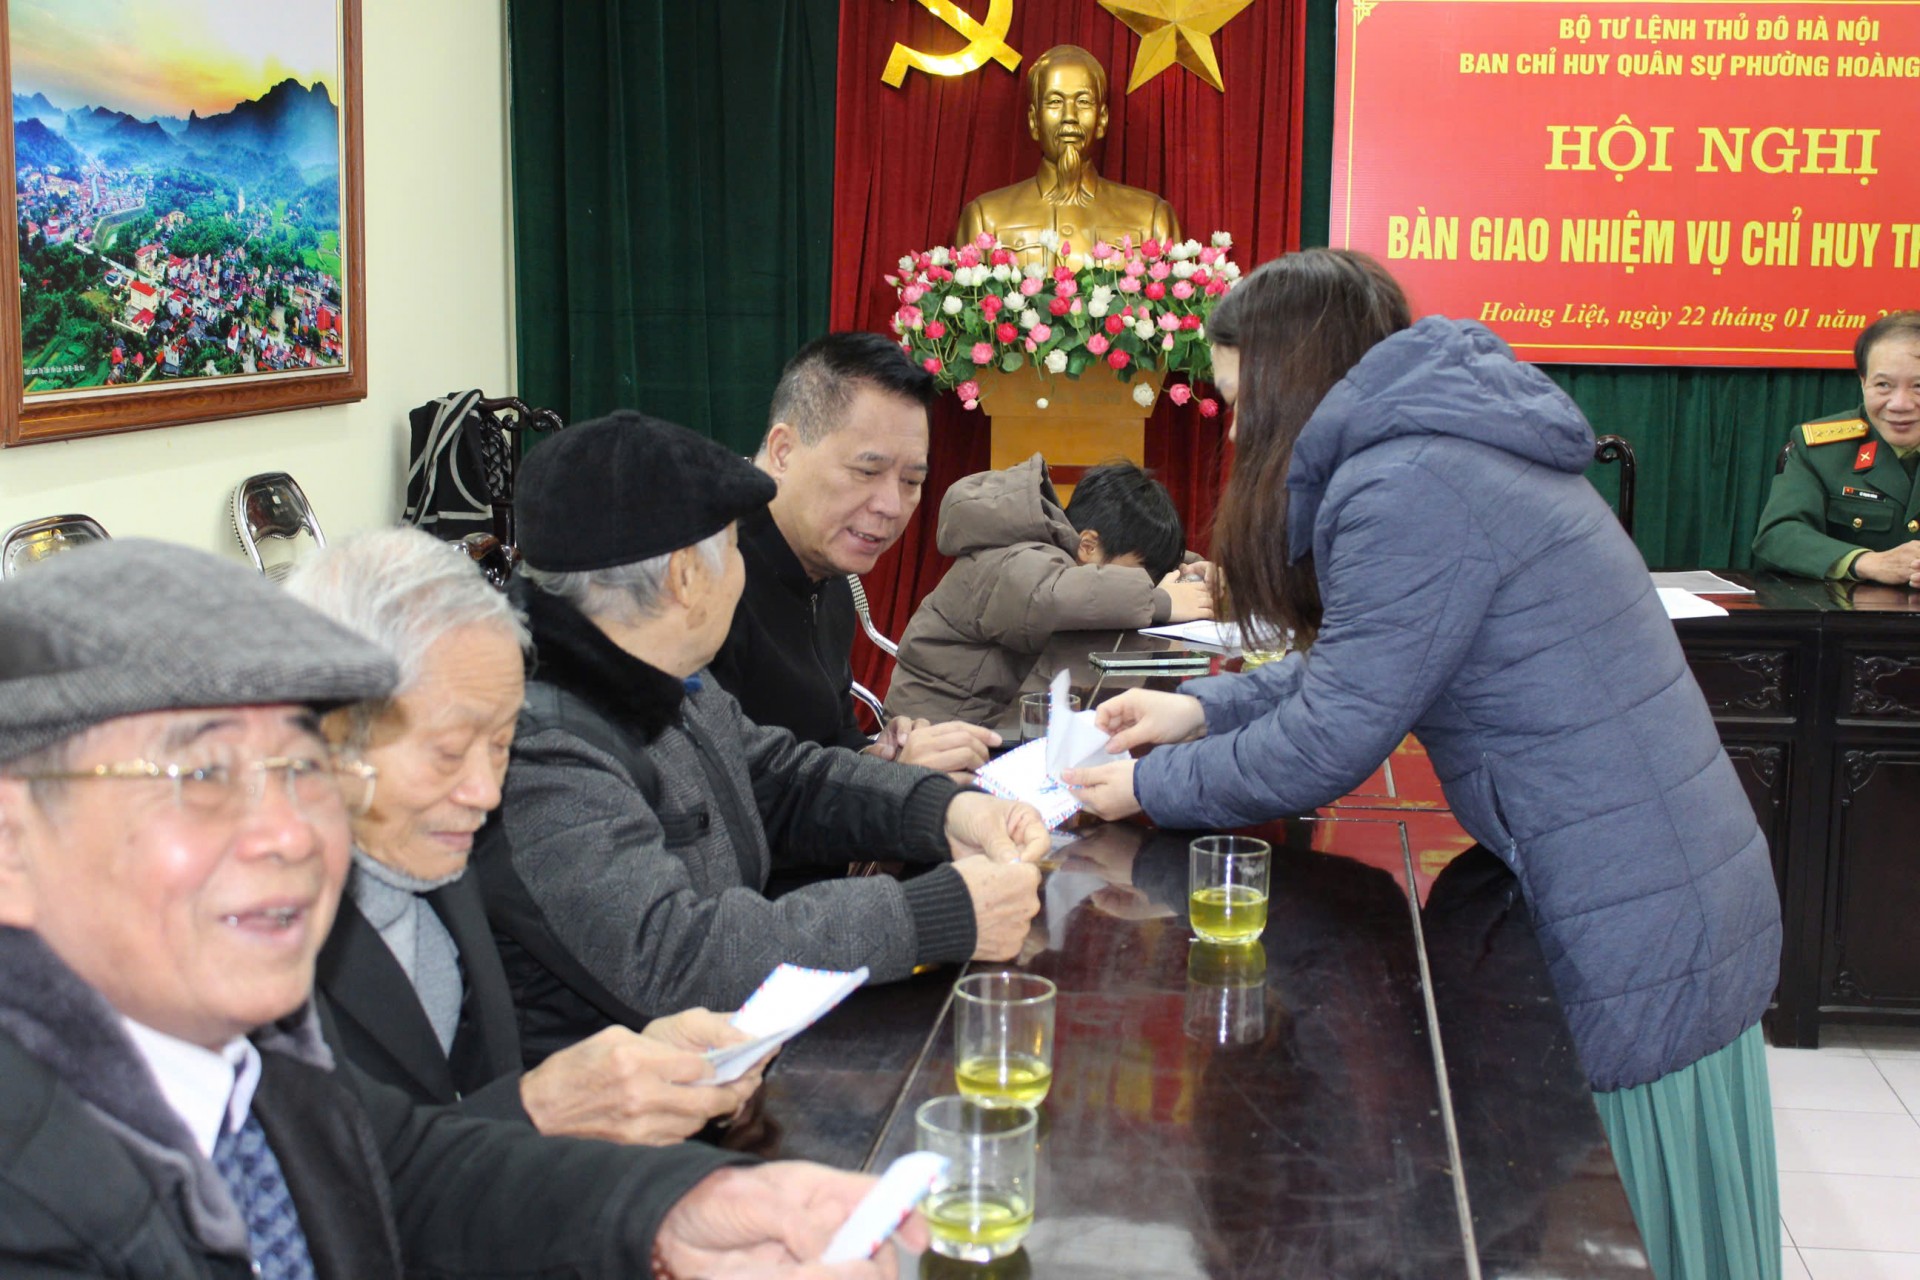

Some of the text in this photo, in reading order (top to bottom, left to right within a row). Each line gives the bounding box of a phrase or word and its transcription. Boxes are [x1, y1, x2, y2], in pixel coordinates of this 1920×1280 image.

[1558, 11, 1880, 47] BỘ TƯ LỆNH THỦ ĐÔ HÀ NỘI
[1458, 46, 1920, 81] BAN CHỈ HUY QUÂN SỰ PHƯỜNG HOÀNG
[1544, 113, 1881, 186] HỘI NGHỊ
[1387, 206, 1460, 261] BÀN
[1469, 216, 1550, 263] GIAO
[1560, 209, 1676, 274] NHIỆM
[1686, 220, 1731, 276] VỤ
[1741, 206, 1803, 267] CHỈ
[1810, 222, 1882, 268] HUY
[1478, 301, 1556, 328] Hoàng
[1560, 303, 1610, 329] Liệt,
[1617, 304, 1673, 330] ngày
[1678, 305, 1706, 326] 22
[1711, 306, 1777, 332] tháng
[1783, 307, 1810, 328] 01
[1816, 309, 1866, 329] năm
